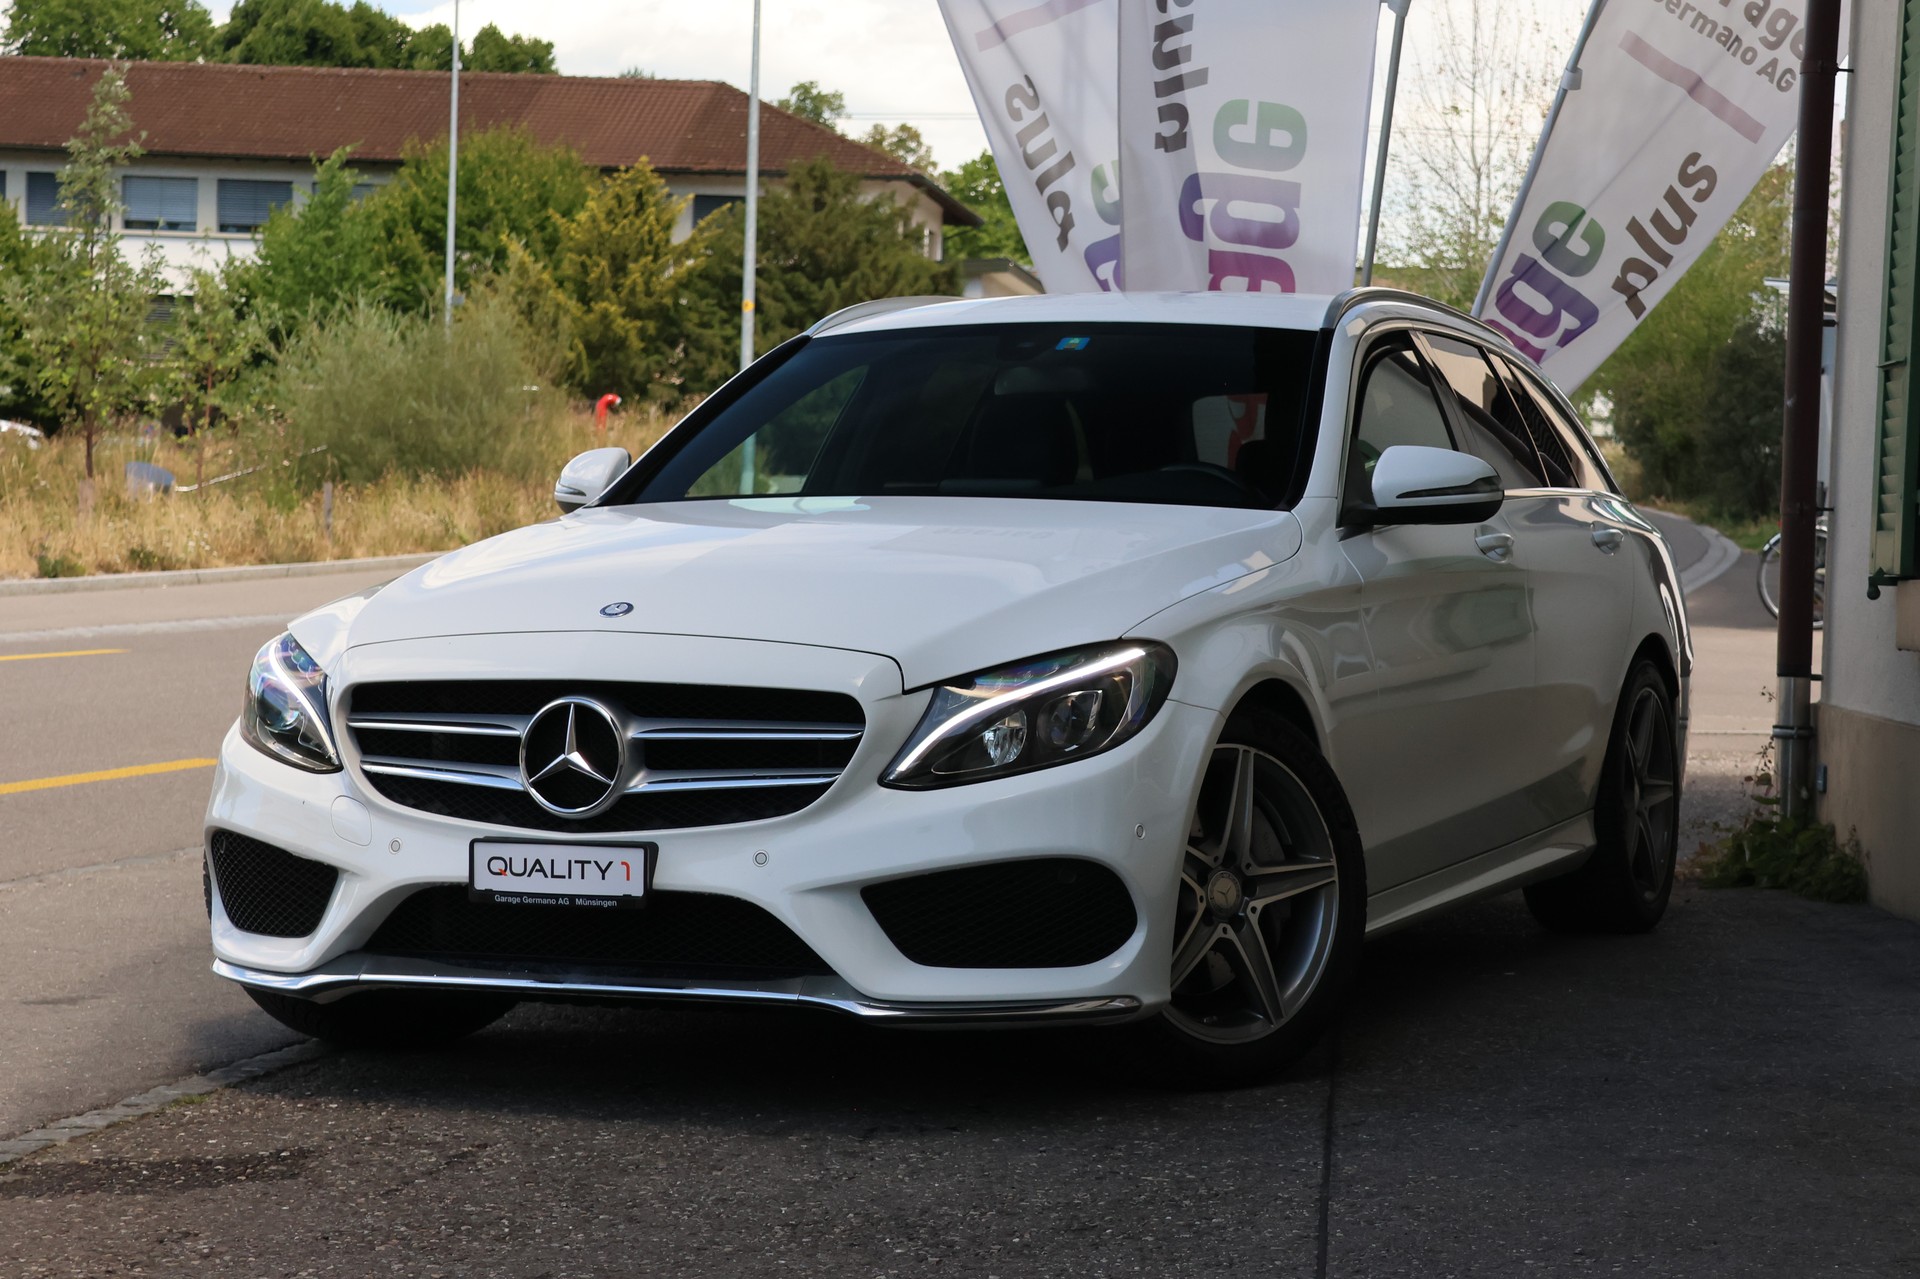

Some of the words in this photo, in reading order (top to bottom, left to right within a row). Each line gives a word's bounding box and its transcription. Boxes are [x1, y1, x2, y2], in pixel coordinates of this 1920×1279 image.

[1650, 0, 1758, 66] ermano
[1756, 57, 1797, 93] AG
[1611, 151, 1718, 321] plus
[494, 894, 521, 904] Garage
[522, 895, 557, 906] Germano
[557, 897, 570, 905] AG
[575, 897, 617, 907] Münsingen
